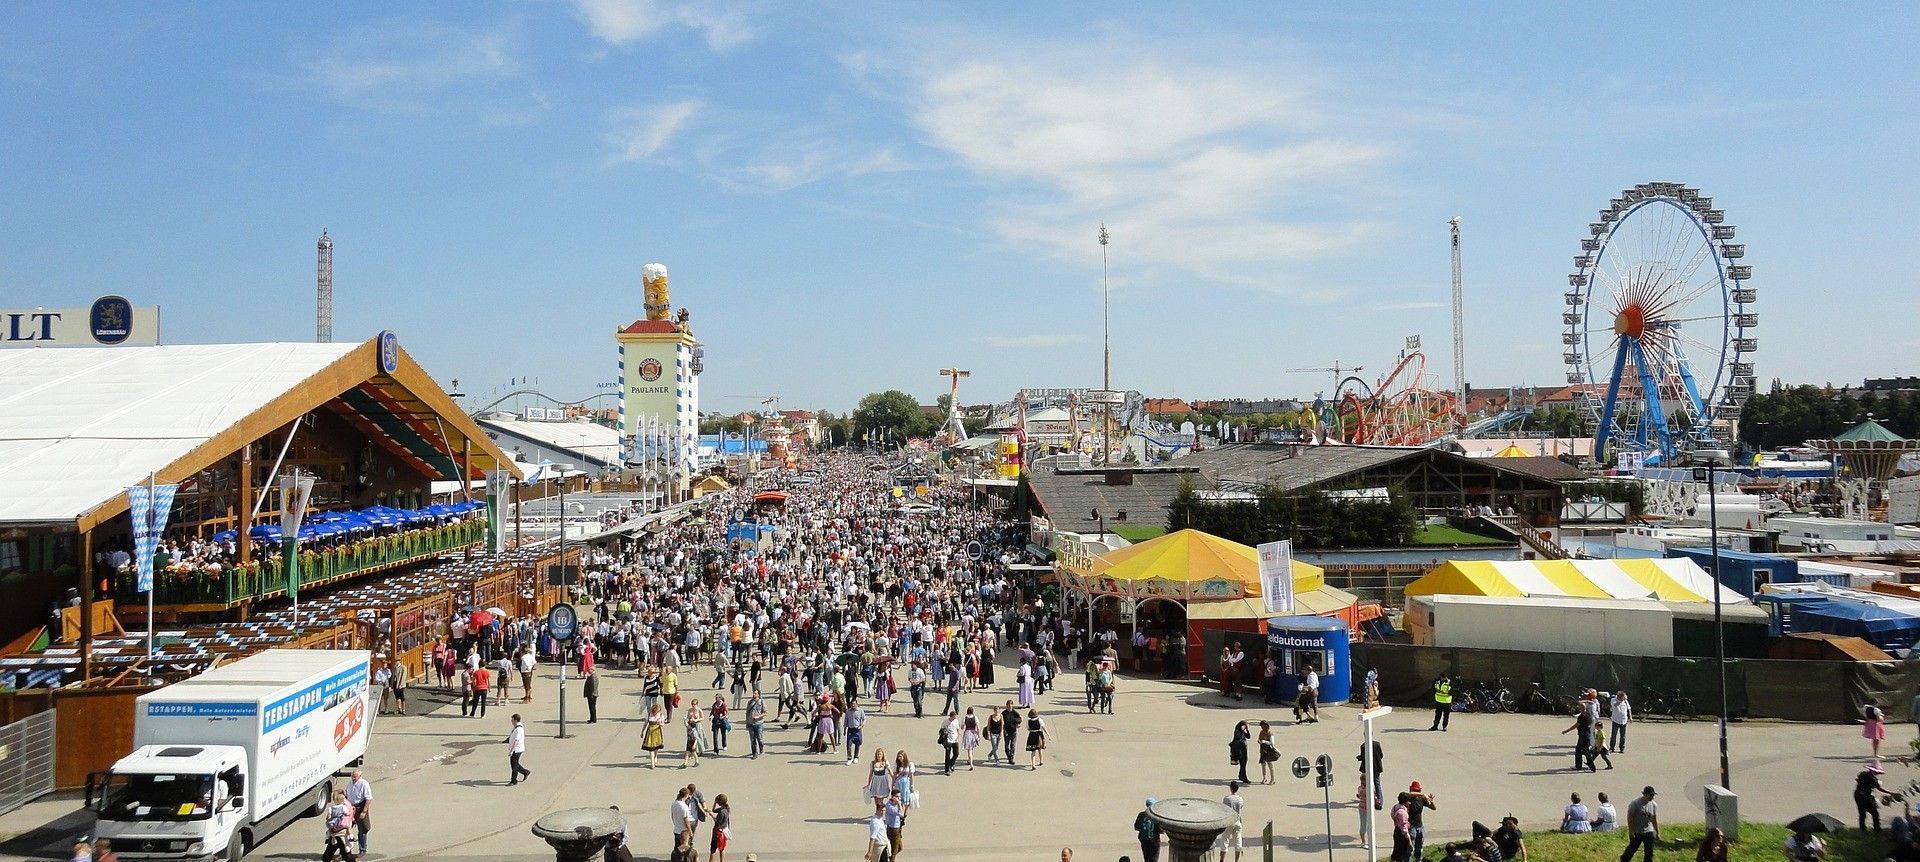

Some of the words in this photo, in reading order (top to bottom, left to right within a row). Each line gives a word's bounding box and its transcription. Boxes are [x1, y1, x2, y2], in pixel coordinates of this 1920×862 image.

[0, 313, 62, 341] LT
[631, 386, 669, 394] PAULANER
[265, 686, 322, 728] TERSTAPPEN
[262, 763, 327, 808] www.terstappen.de
